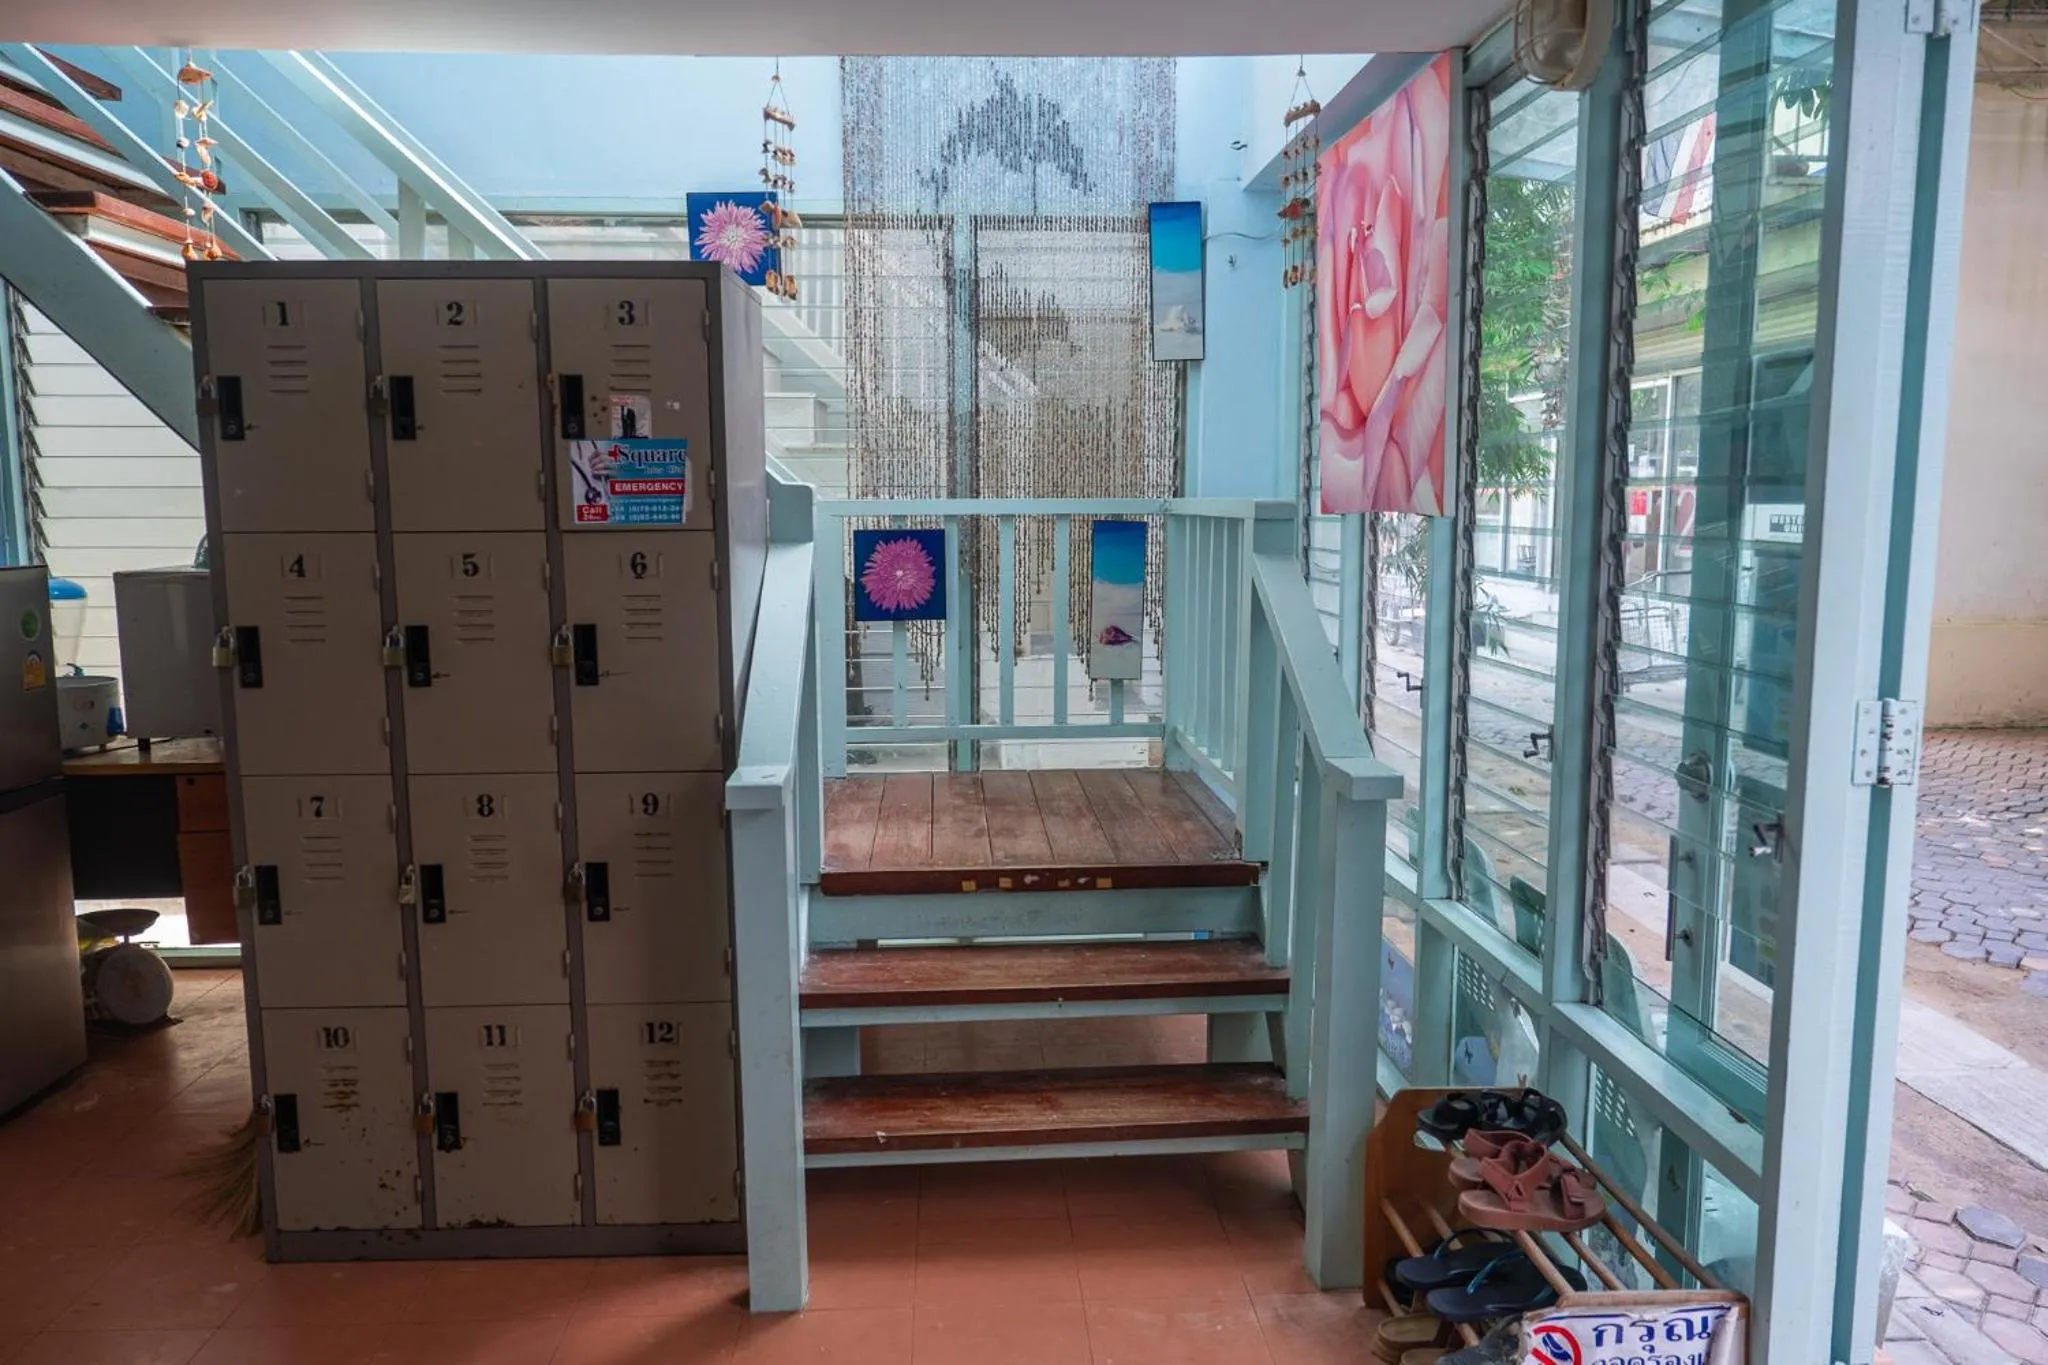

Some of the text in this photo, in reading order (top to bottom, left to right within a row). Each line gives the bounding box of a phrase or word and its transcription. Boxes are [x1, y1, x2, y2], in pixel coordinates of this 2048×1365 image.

[276, 302, 290, 326] 1
[446, 302, 464, 326] 2
[617, 301, 635, 326] 3
[618, 444, 686, 467] Square
[614, 482, 683, 492] EMERGENCY
[582, 505, 602, 514] Call
[289, 554, 306, 578] 4
[462, 553, 480, 577] 5
[631, 552, 648, 579] 6
[310, 796, 325, 818] 7
[477, 794, 494, 818] 8
[642, 793, 659, 816] 9
[323, 1027, 350, 1048] 10
[483, 1025, 506, 1047] 11
[646, 1022, 674, 1044] 12
[1592, 1315, 1726, 1354] กรุณ
